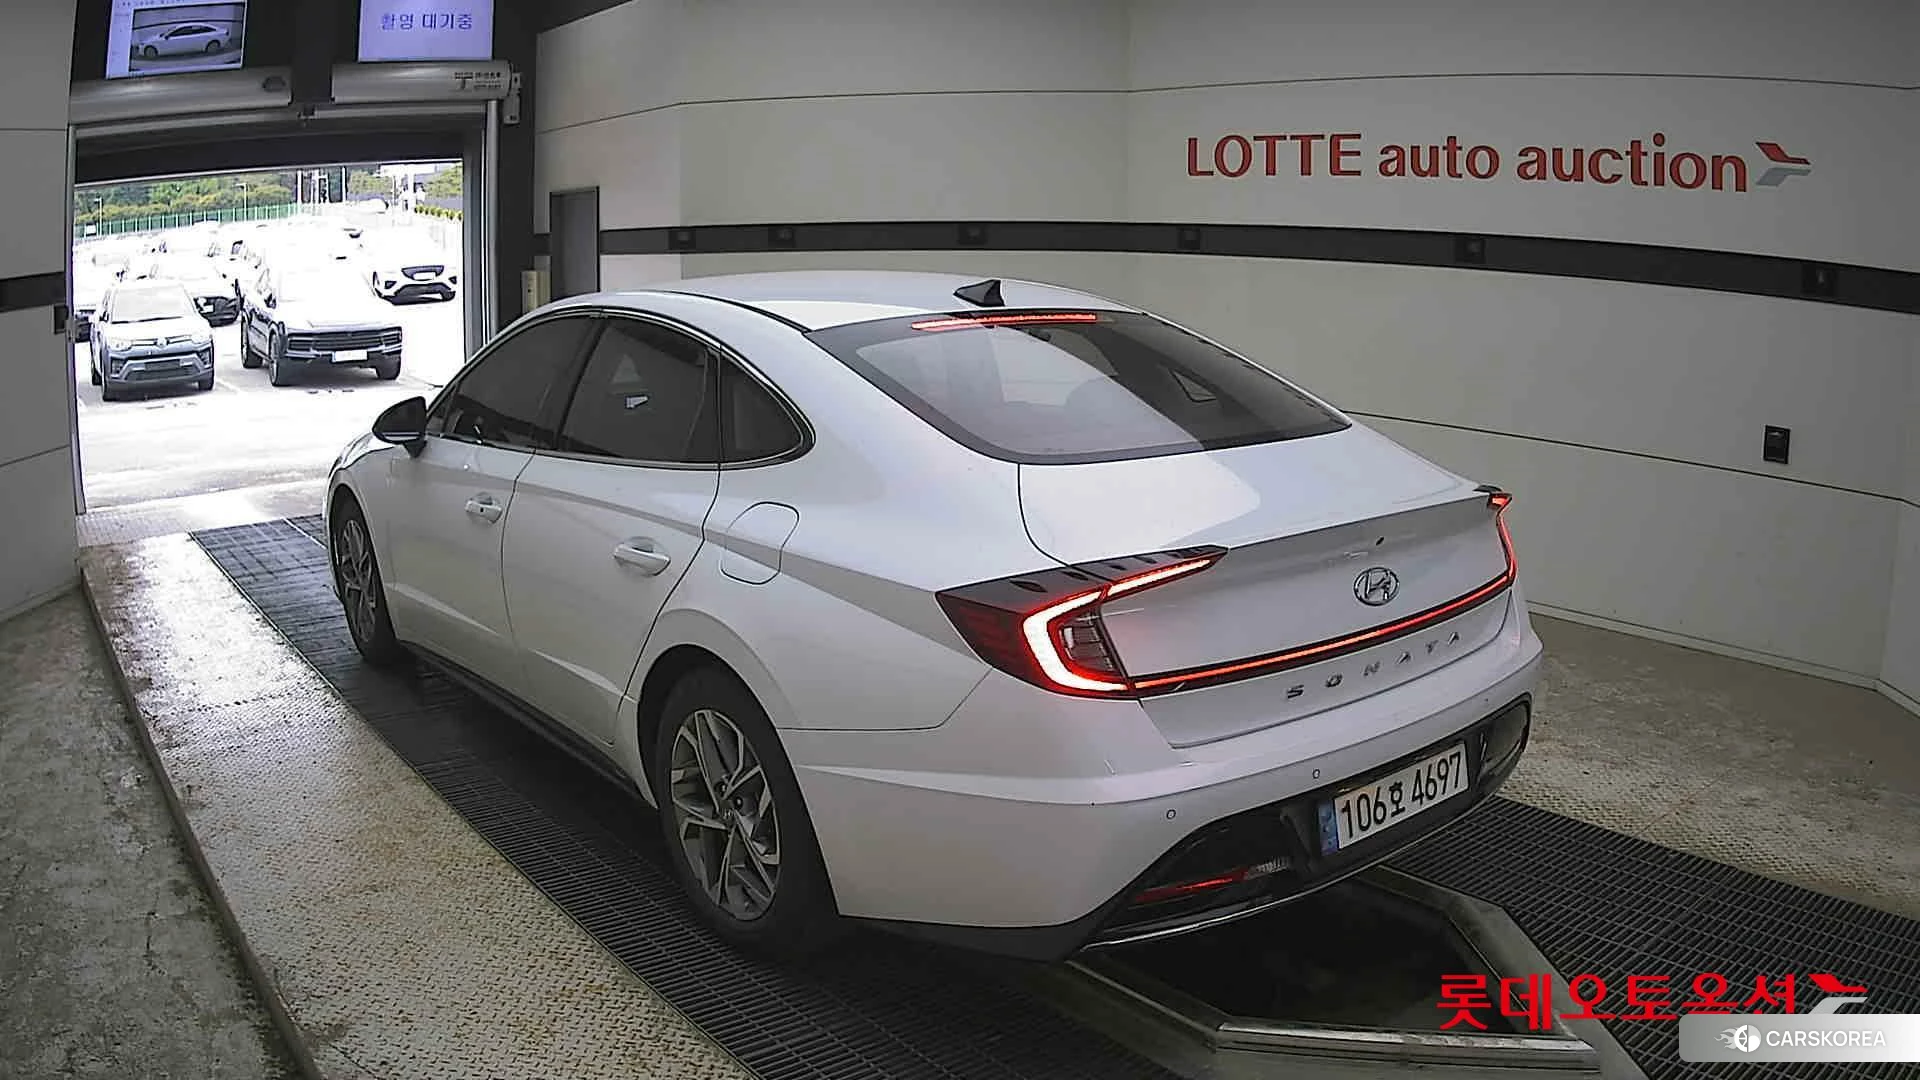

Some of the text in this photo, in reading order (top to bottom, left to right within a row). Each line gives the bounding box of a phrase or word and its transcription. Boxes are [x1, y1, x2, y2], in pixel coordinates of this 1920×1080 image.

[422, 13, 473, 30] 대기중
[1188, 133, 1747, 192] LOTTE auto auction
[1286, 631, 1461, 699] SONATA
[1341, 780, 1406, 839] 106호
[1411, 751, 1462, 805] 4697
